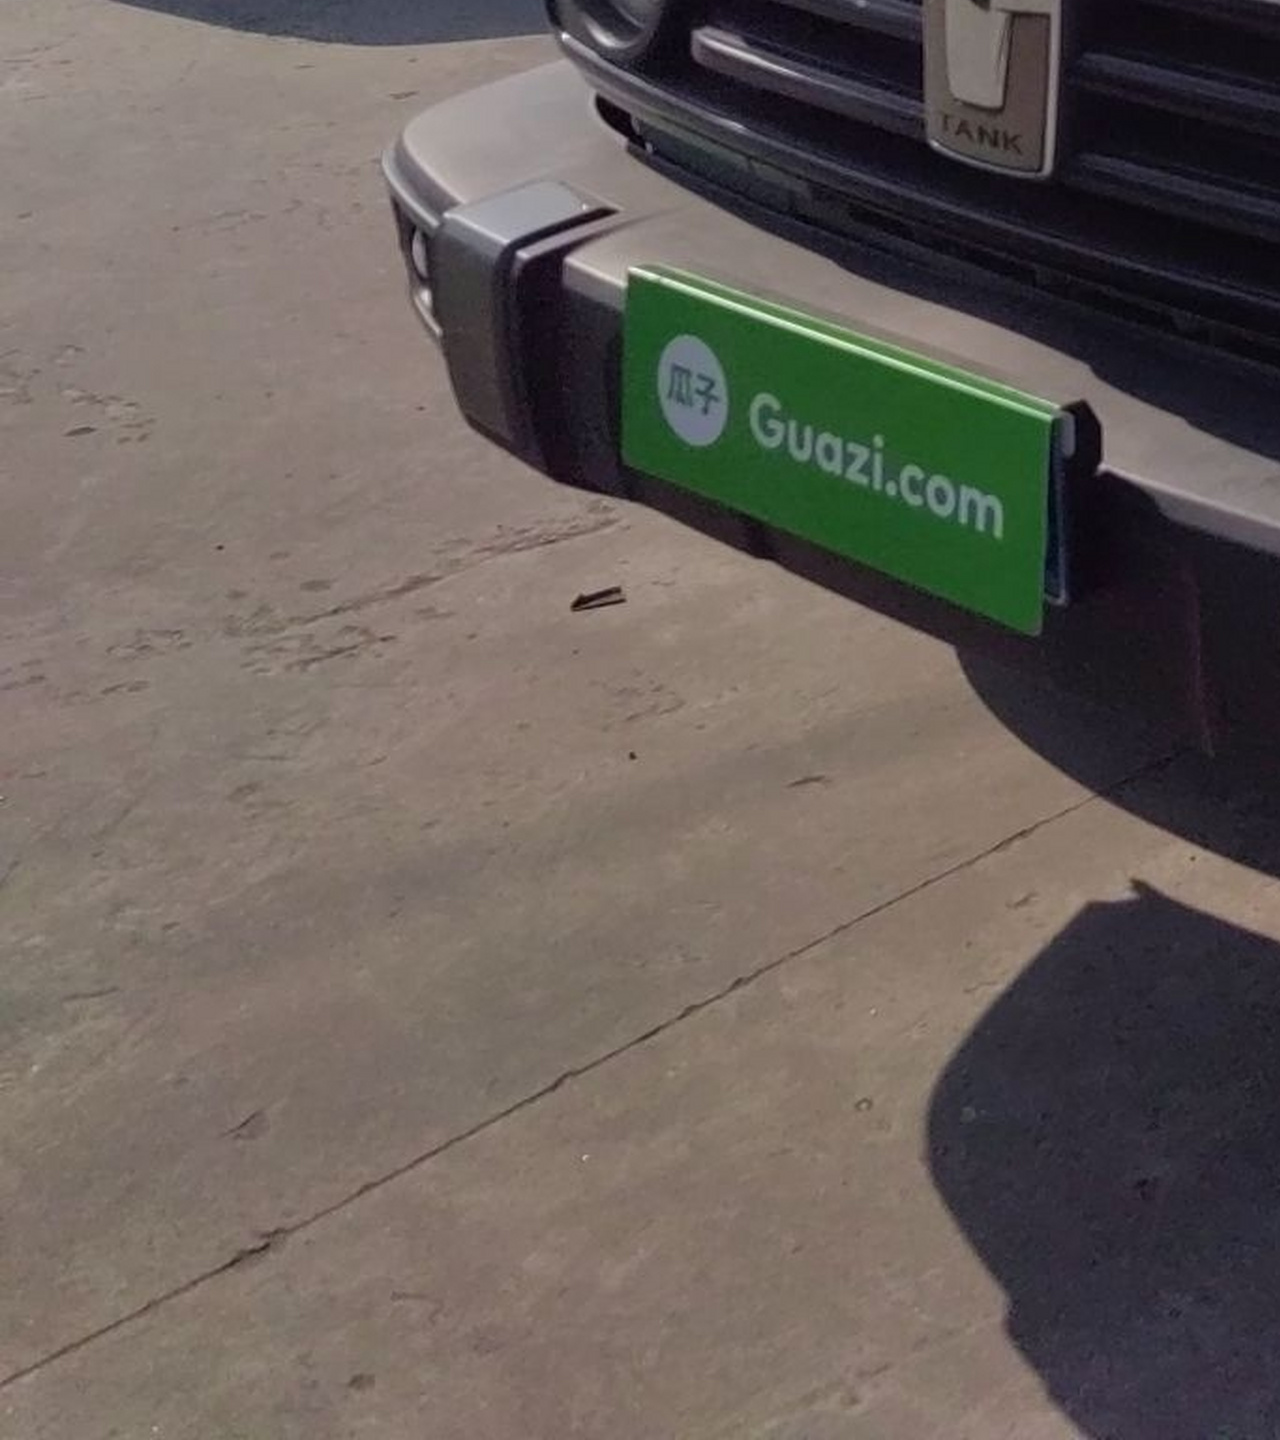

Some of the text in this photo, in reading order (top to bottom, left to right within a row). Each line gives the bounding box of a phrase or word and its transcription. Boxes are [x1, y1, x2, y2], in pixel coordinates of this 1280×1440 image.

[939, 112, 1023, 156] TANK
[667, 362, 1004, 540] 瓜子 Guazi.com
